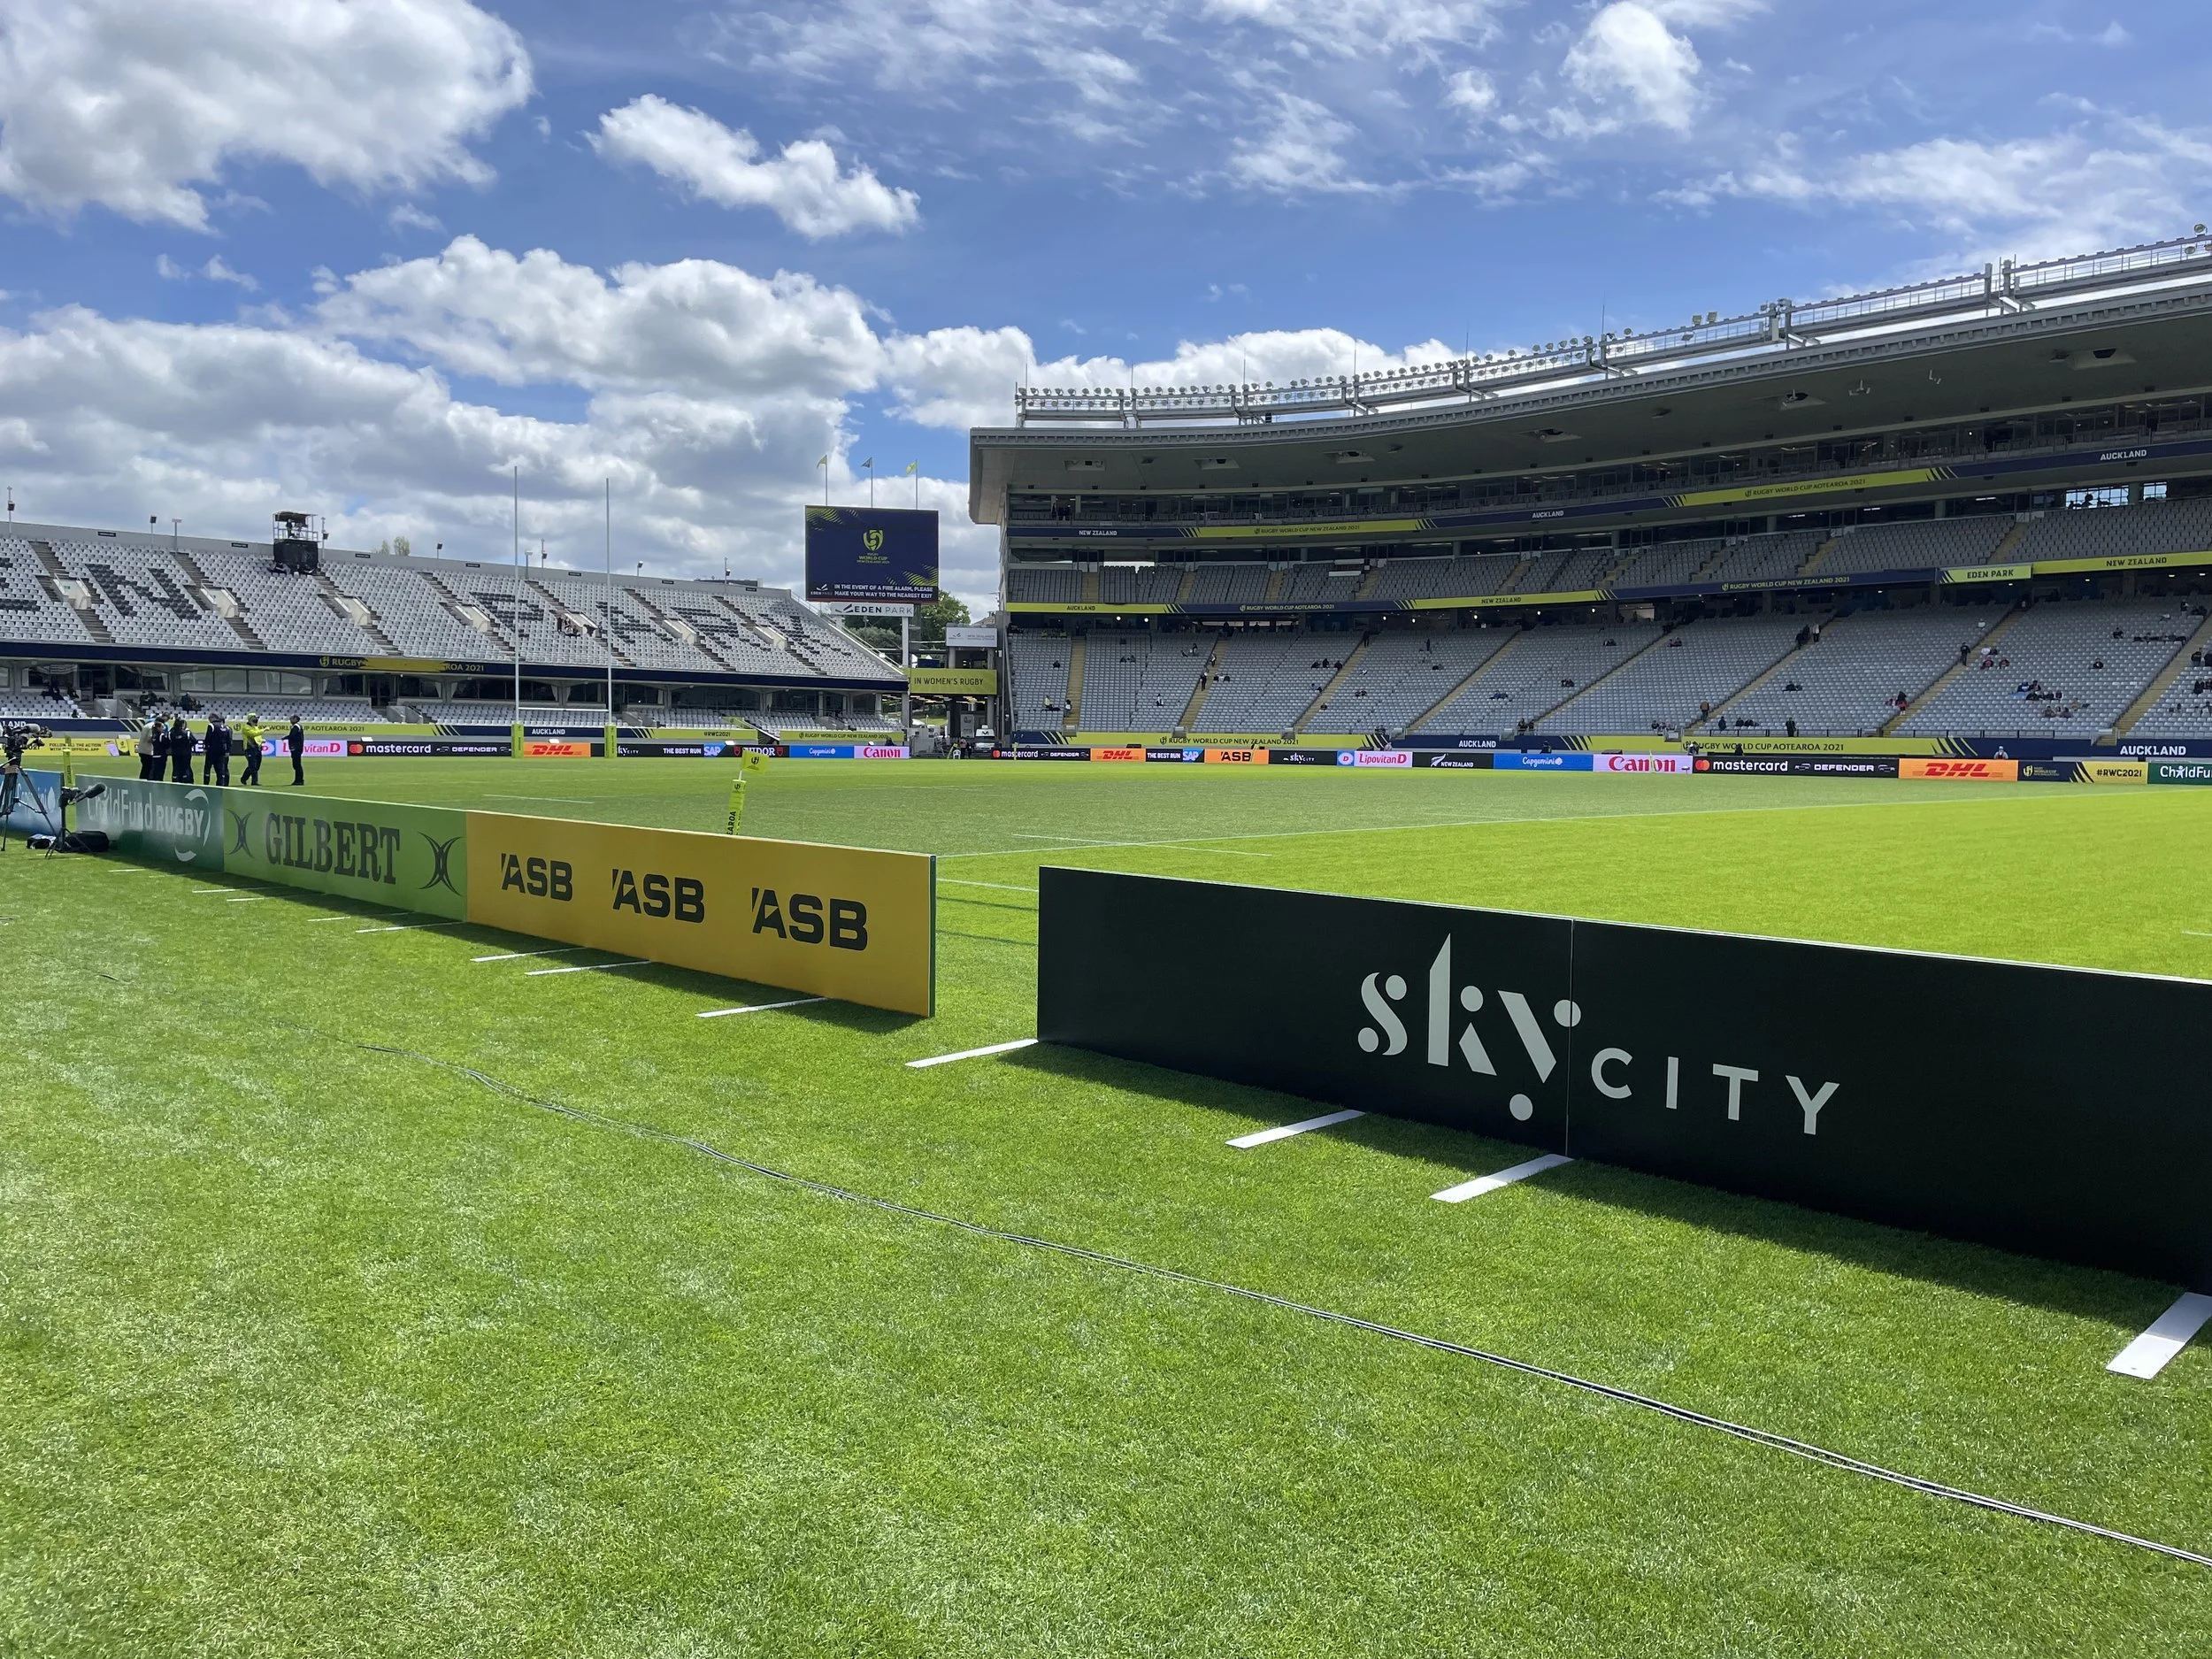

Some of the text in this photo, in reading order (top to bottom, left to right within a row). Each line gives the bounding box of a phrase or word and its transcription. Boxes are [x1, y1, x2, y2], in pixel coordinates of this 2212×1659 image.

[2100, 449, 2147, 461] AUCKLAND
[1813, 480, 1849, 490] AOTEAROA
[1532, 510, 1564, 519] AUCKLAND
[2106, 557, 2167, 567] NEW ZEALAND
[1967, 569, 2014, 579] EDEN PARK
[366, 744, 431, 753] mastercard
[1459, 740, 1496, 748] AUCKLAND
[532, 745, 574, 755] DHL
[704, 747, 721, 756] SAP
[809, 747, 831, 756] Capgemini
[863, 747, 900, 758] Canon
[1102, 750, 1133, 760] DHL
[1183, 751, 1199, 760] SAP
[2120, 745, 2186, 756] AUCKLAND
[1221, 751, 1252, 762] ASB
[1522, 757, 1555, 768] Capgemini
[1609, 756, 1676, 772] Canon
[1713, 760, 1788, 772] mastercard
[1924, 763, 1990, 777] DHL
[2097, 769, 2142, 777] #RWC2021
[2160, 766, 2212, 779] ChildFu
[156, 805, 204, 838] RUGBY
[266, 812, 400, 885] GILBERT
[501, 853, 572, 902] ASB
[612, 868, 706, 923] ASB
[752, 887, 868, 952] ASB
